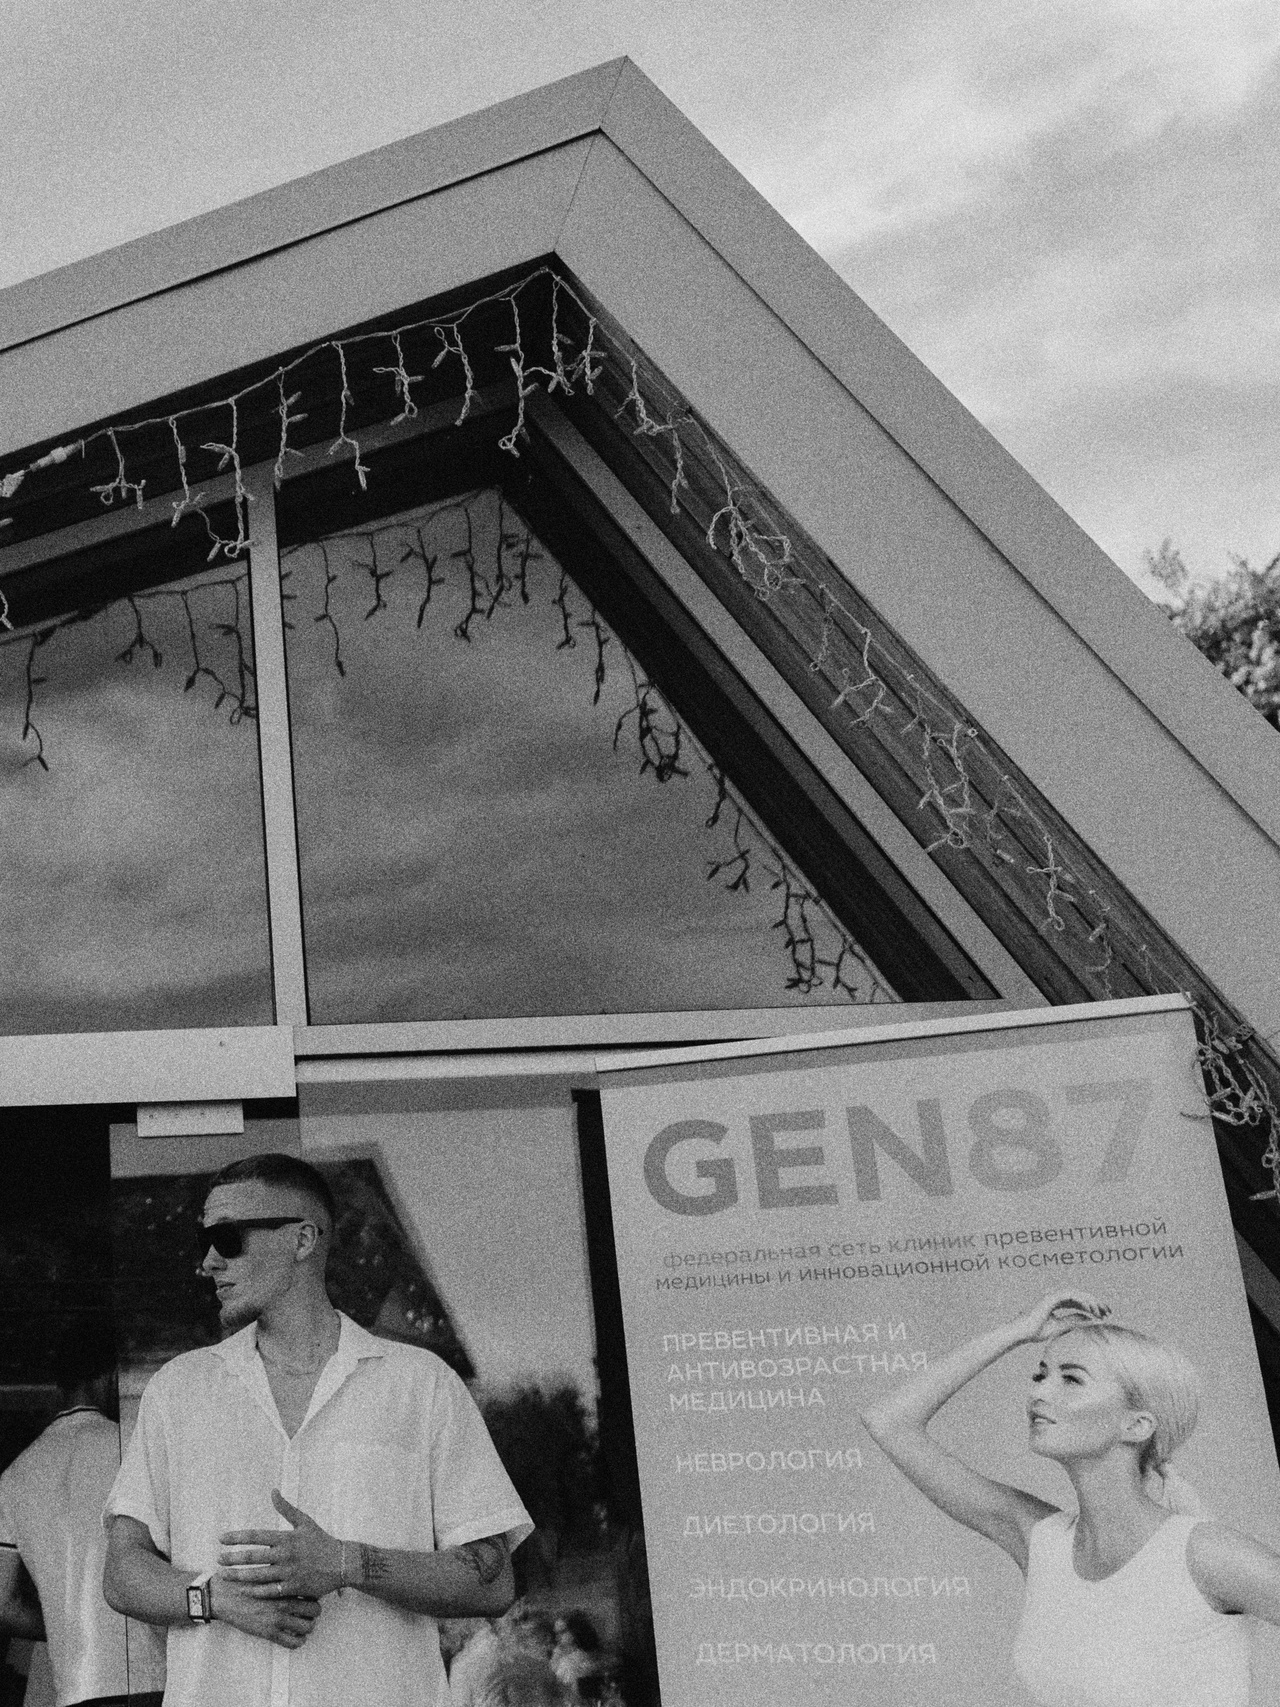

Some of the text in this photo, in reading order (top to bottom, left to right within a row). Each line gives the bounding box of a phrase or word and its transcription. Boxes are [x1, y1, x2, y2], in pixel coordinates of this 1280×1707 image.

[643, 1078, 1151, 1216] GEN87
[663, 1217, 1167, 1270] федеральная сеть клиник превентивной
[656, 1244, 1184, 1291] медицины и инновационной косметологии
[663, 1322, 907, 1351] ПРЕВЕНТИВНАЯ И
[667, 1351, 928, 1382] АНТИВОЗРАСТНАЯ
[669, 1387, 826, 1413] МЕДИЦИНА
[675, 1447, 863, 1475] НЕВРОЛОГИЯ
[683, 1511, 876, 1539] ДИЕТОЛОГИЯ
[690, 1576, 971, 1602] ЭНДОКРИНОЛОГИЯ
[695, 1642, 937, 1668] ДЕРМАТОЛОГИЯ
